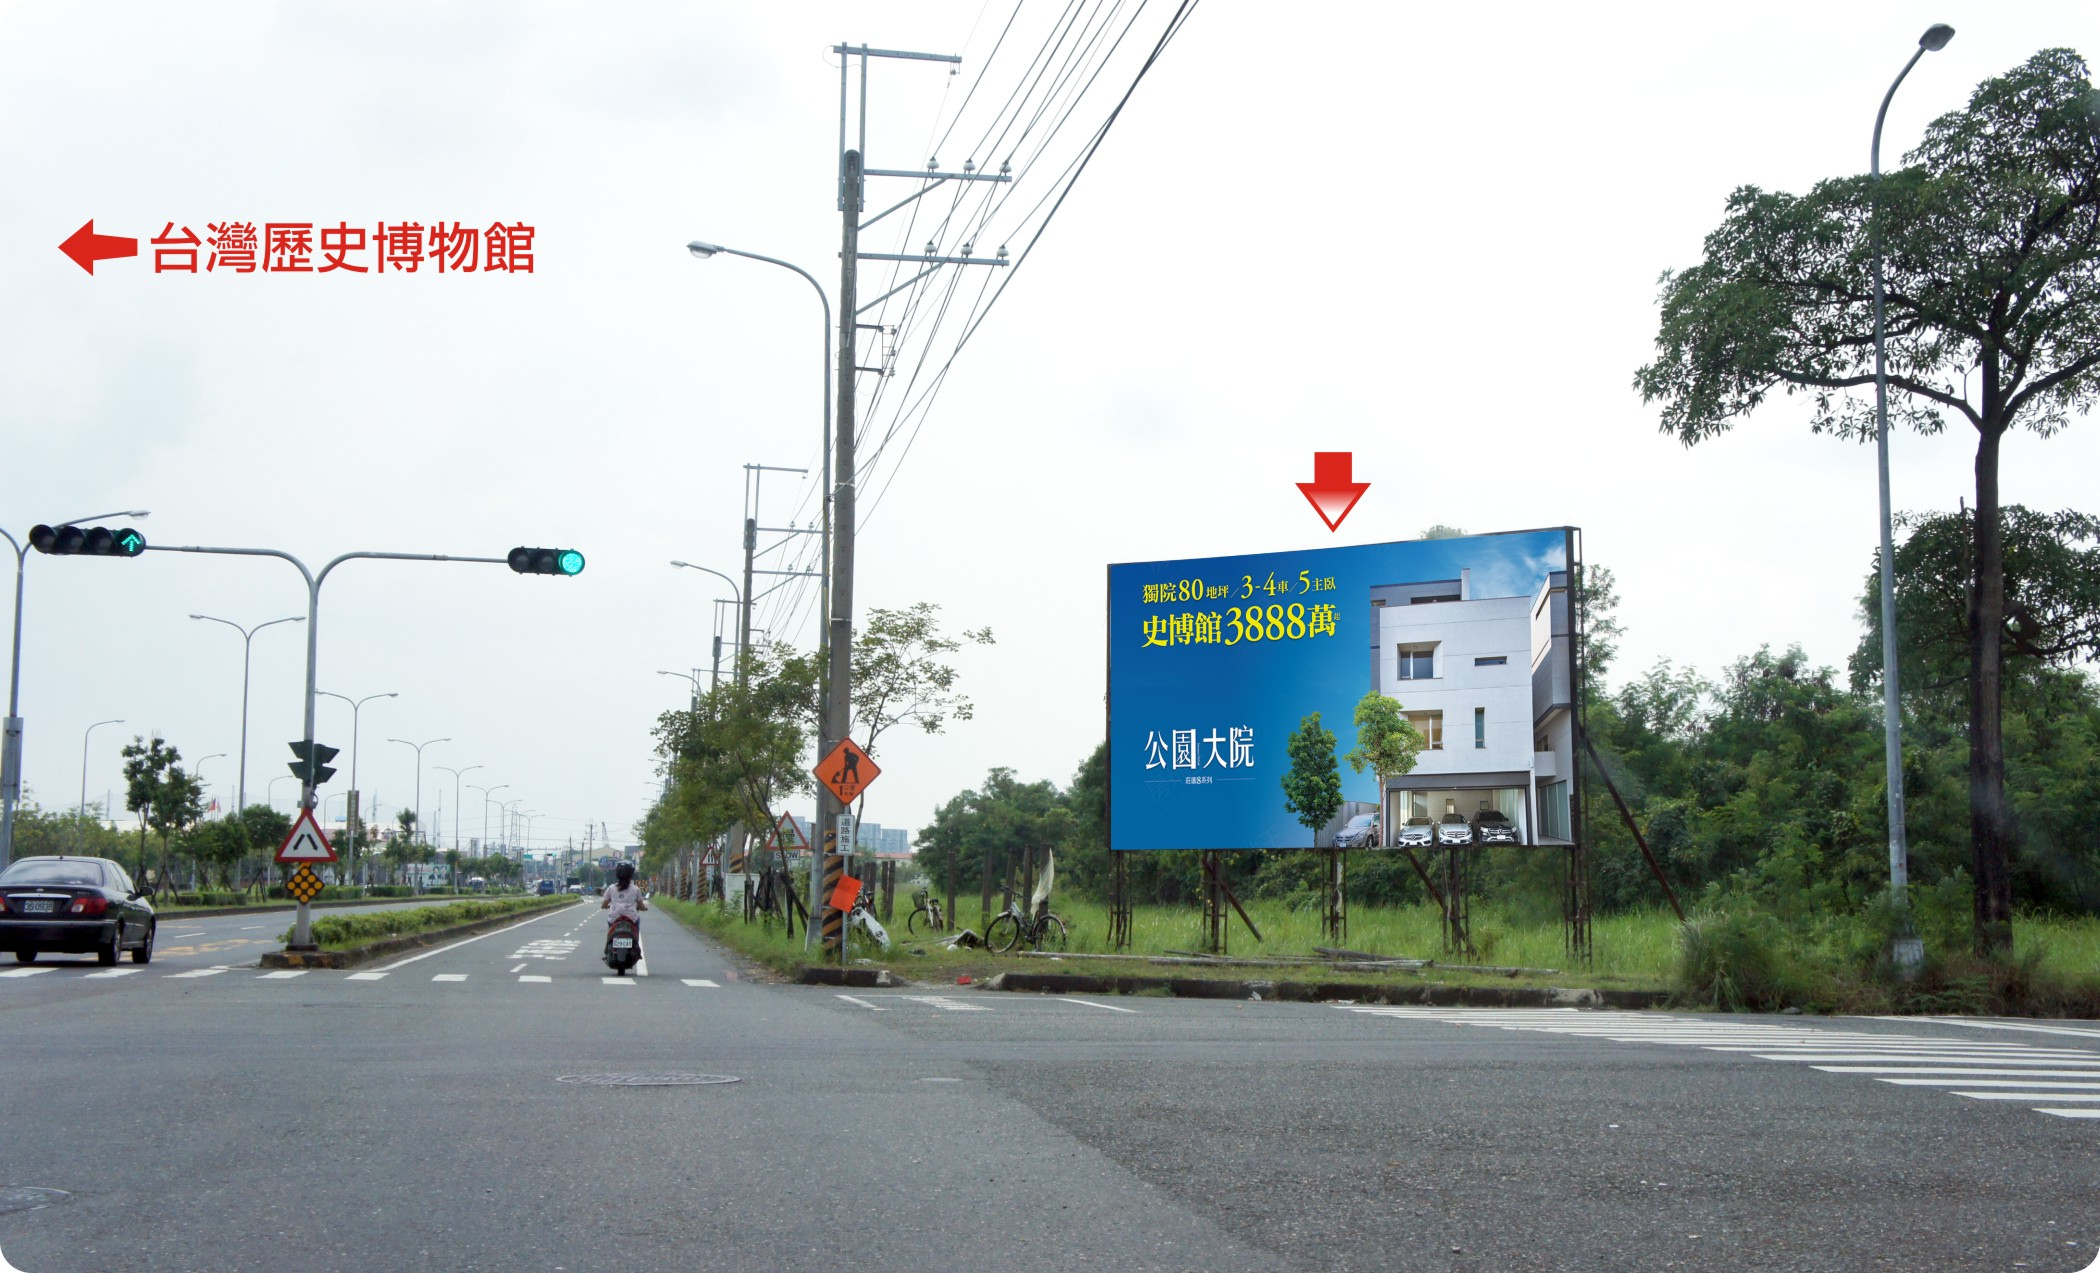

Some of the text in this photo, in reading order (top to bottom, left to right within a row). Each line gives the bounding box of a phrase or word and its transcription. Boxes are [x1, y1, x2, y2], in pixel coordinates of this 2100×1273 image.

[1144, 724, 1255, 770] 公園大院
[840, 817, 851, 852] 道路施工
